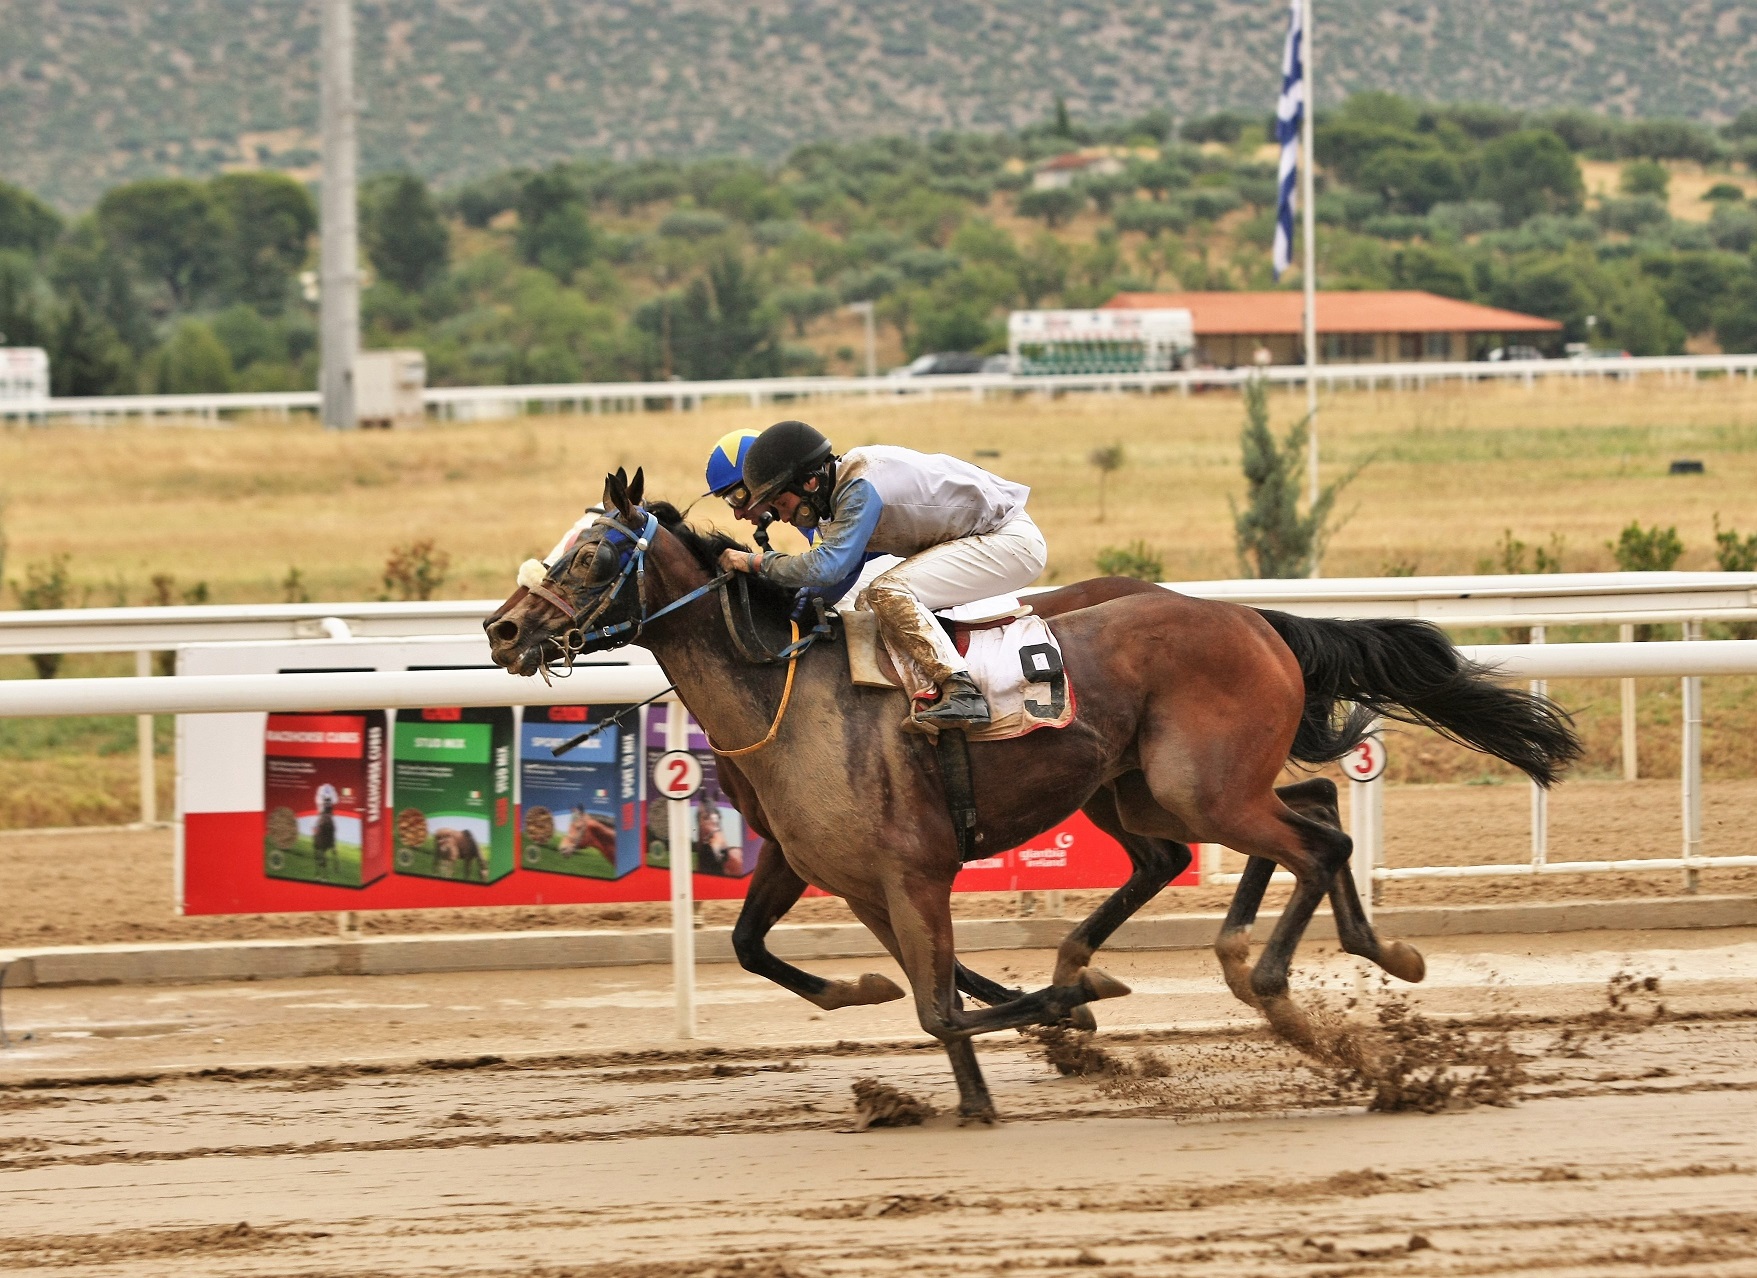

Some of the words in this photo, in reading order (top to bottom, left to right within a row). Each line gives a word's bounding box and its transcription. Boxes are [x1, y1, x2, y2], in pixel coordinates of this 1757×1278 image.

[1019, 642, 1066, 719] 9
[1353, 742, 1374, 774] 3
[669, 759, 690, 791] 2
[1018, 848, 1067, 861] glanbia
